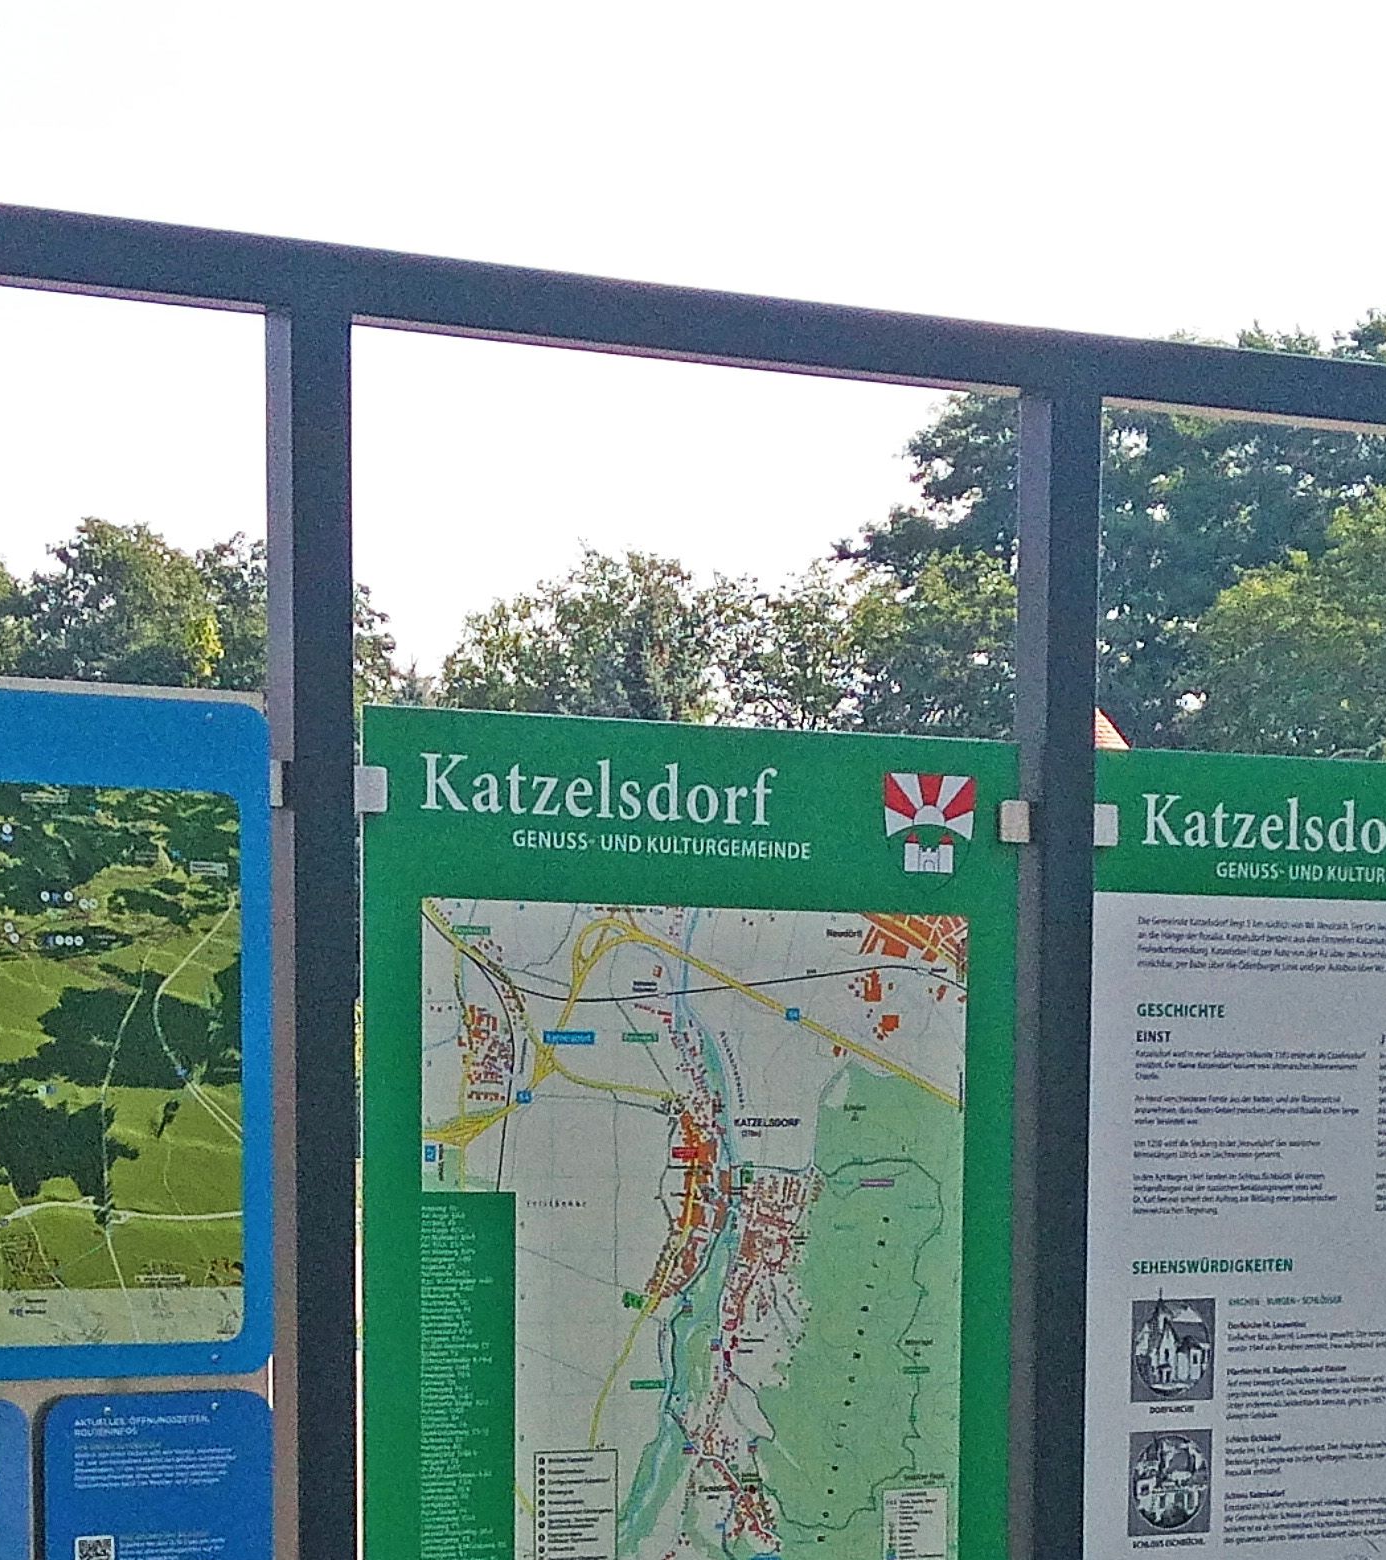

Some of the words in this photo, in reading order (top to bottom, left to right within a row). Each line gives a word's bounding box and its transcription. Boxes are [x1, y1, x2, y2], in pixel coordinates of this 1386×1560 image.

[420, 751, 778, 826] Katzelsdorf
[513, 829, 595, 851] GENUSS-
[600, 833, 642, 854] UND
[646, 836, 812, 860] KULTURGEMEINDE
[1216, 861, 1285, 879] GENUSS-
[1289, 864, 1323, 882] UND
[1136, 1003, 1225, 1018] GESCHICHTE
[1136, 1031, 1172, 1042] EINST
[1133, 1257, 1293, 1275] SEHENSWÜRDIGKEITEN
